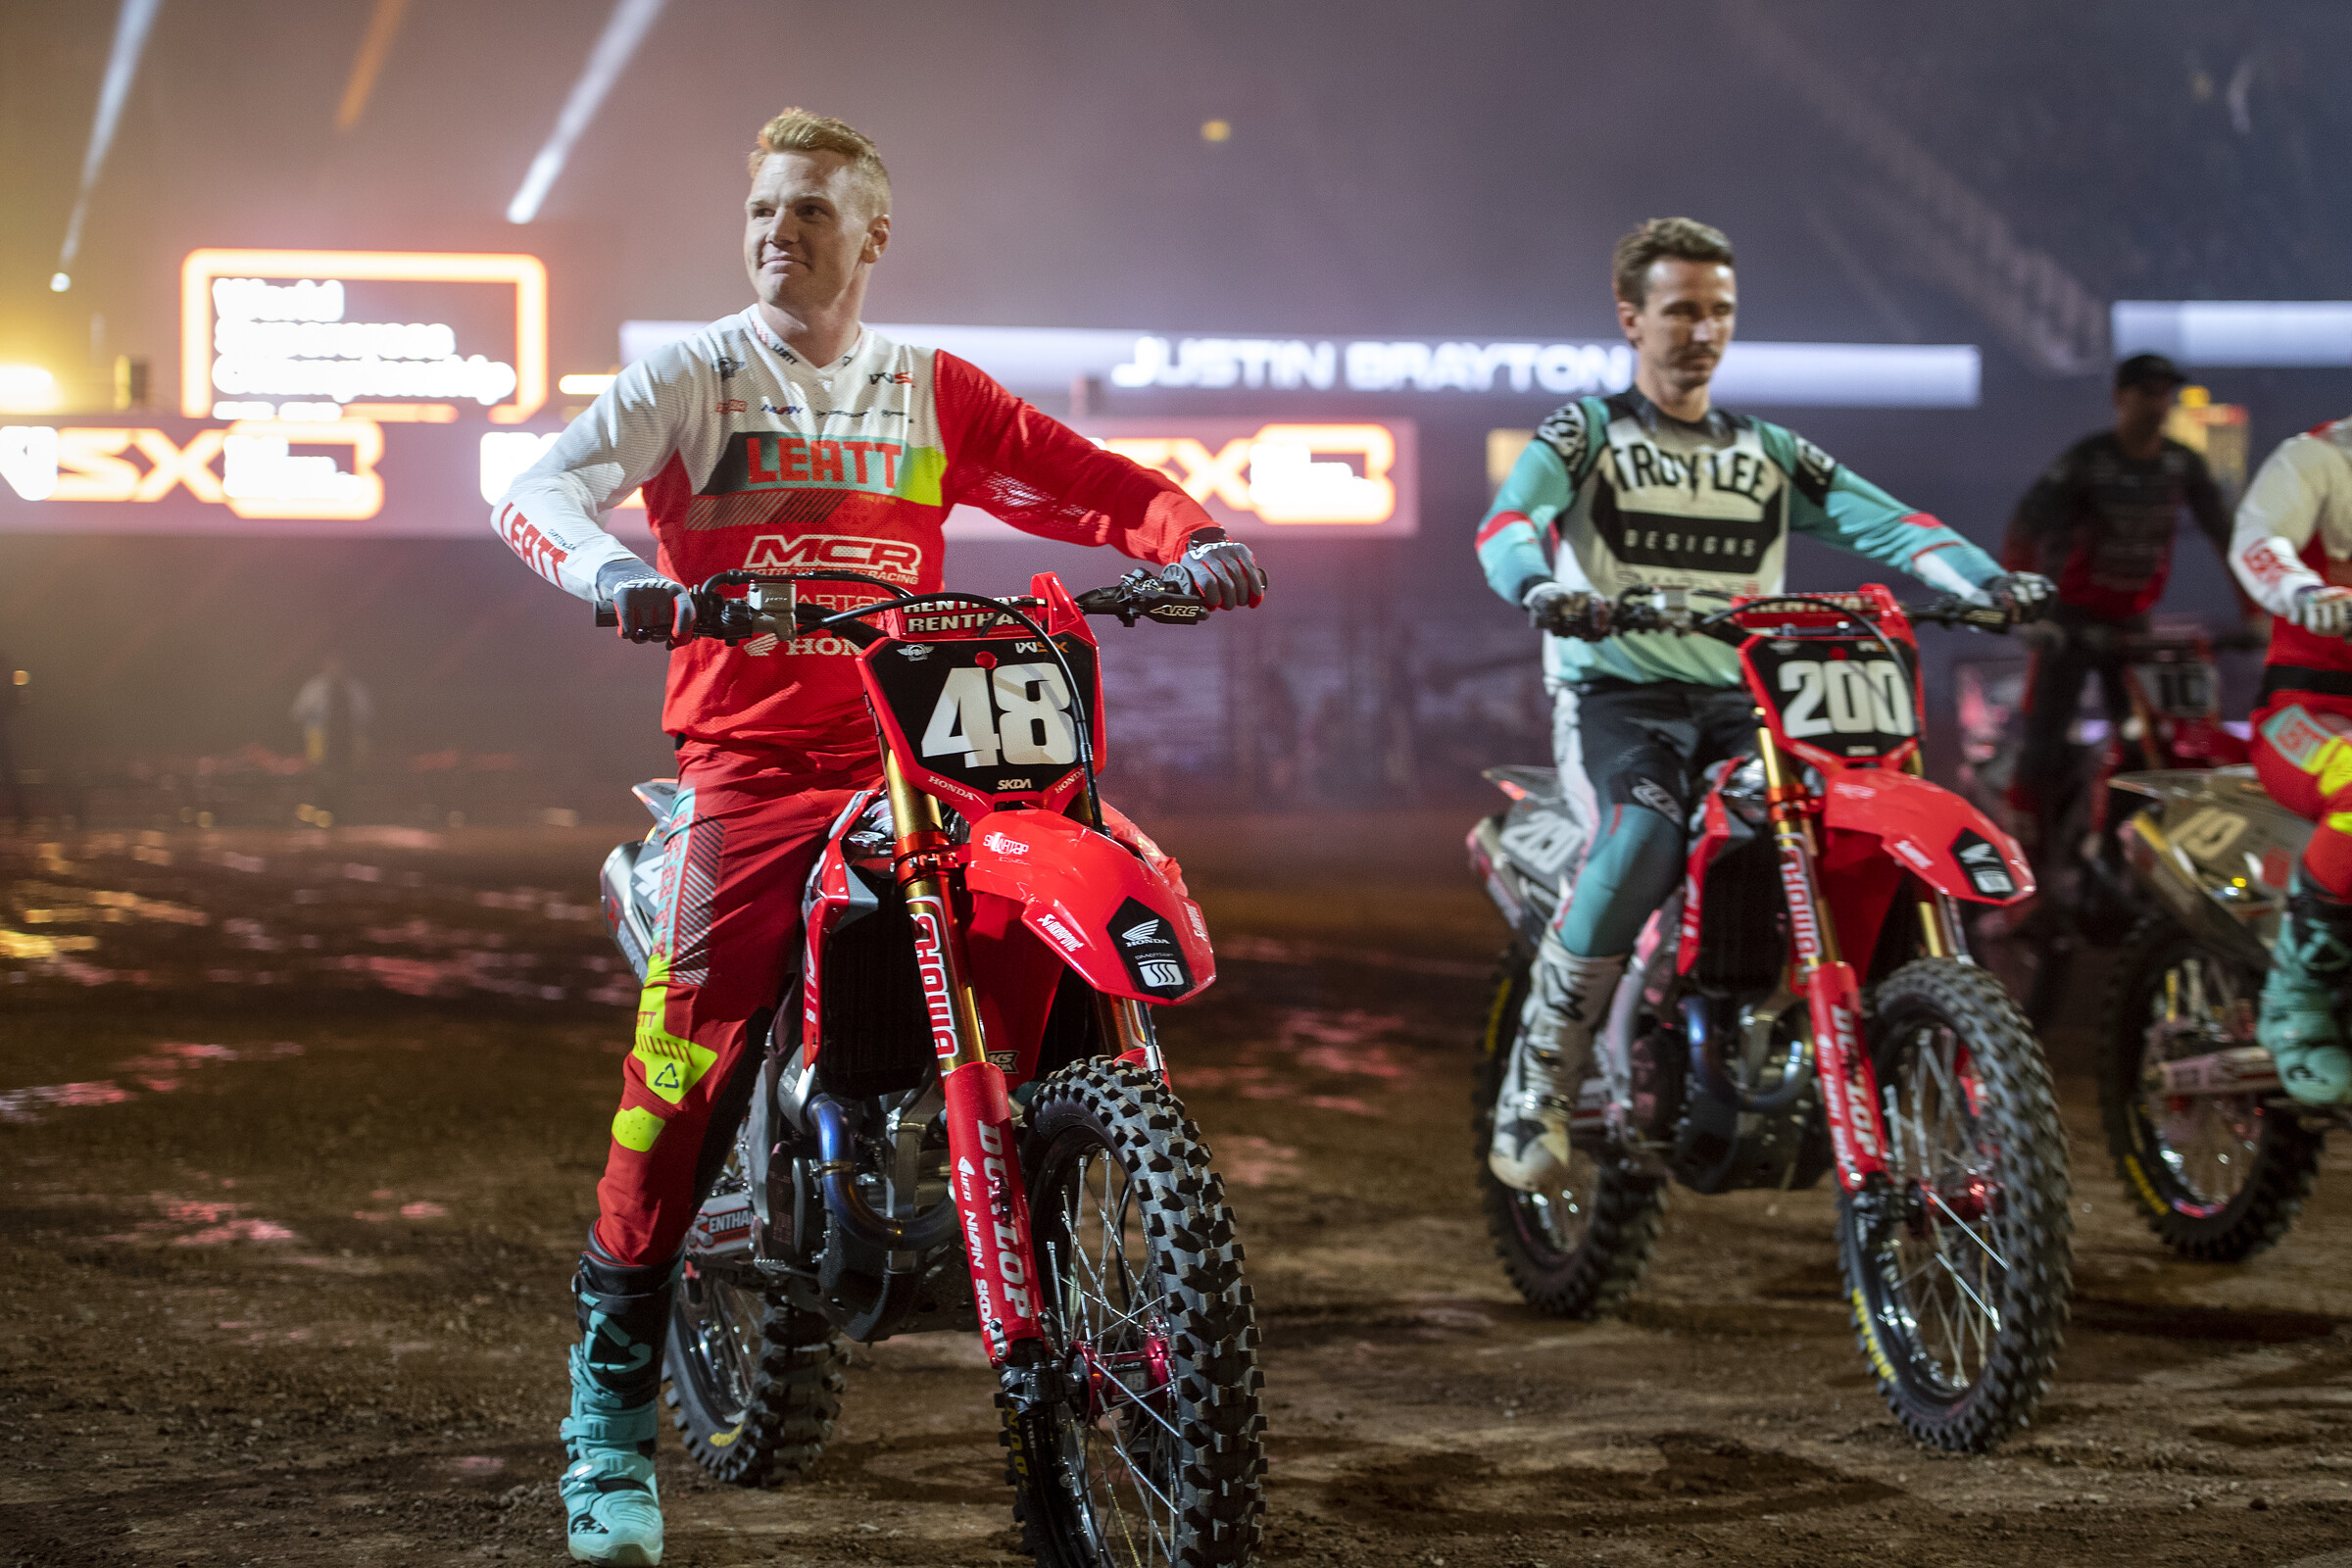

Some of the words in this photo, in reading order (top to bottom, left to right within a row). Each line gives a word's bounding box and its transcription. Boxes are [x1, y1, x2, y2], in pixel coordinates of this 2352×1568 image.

[1111, 335, 1336, 389] JUSTIN
[1347, 339, 1634, 392] BRAYTON
[747, 437, 902, 489] LEATT
[1612, 444, 1698, 496] TROY
[1711, 452, 1766, 506] LEE
[500, 502, 568, 588] LEATT
[742, 534, 922, 576] MCR
[1623, 528, 1757, 558] DESIGNS
[1150, 605, 1200, 616] ARC
[785, 638, 866, 656] HON
[921, 662, 1077, 768] 48
[1778, 661, 1916, 739] 200
[929, 775, 974, 801] HONDA
[997, 779, 1032, 790] SKDA
[1126, 937, 1170, 948] HONDA
